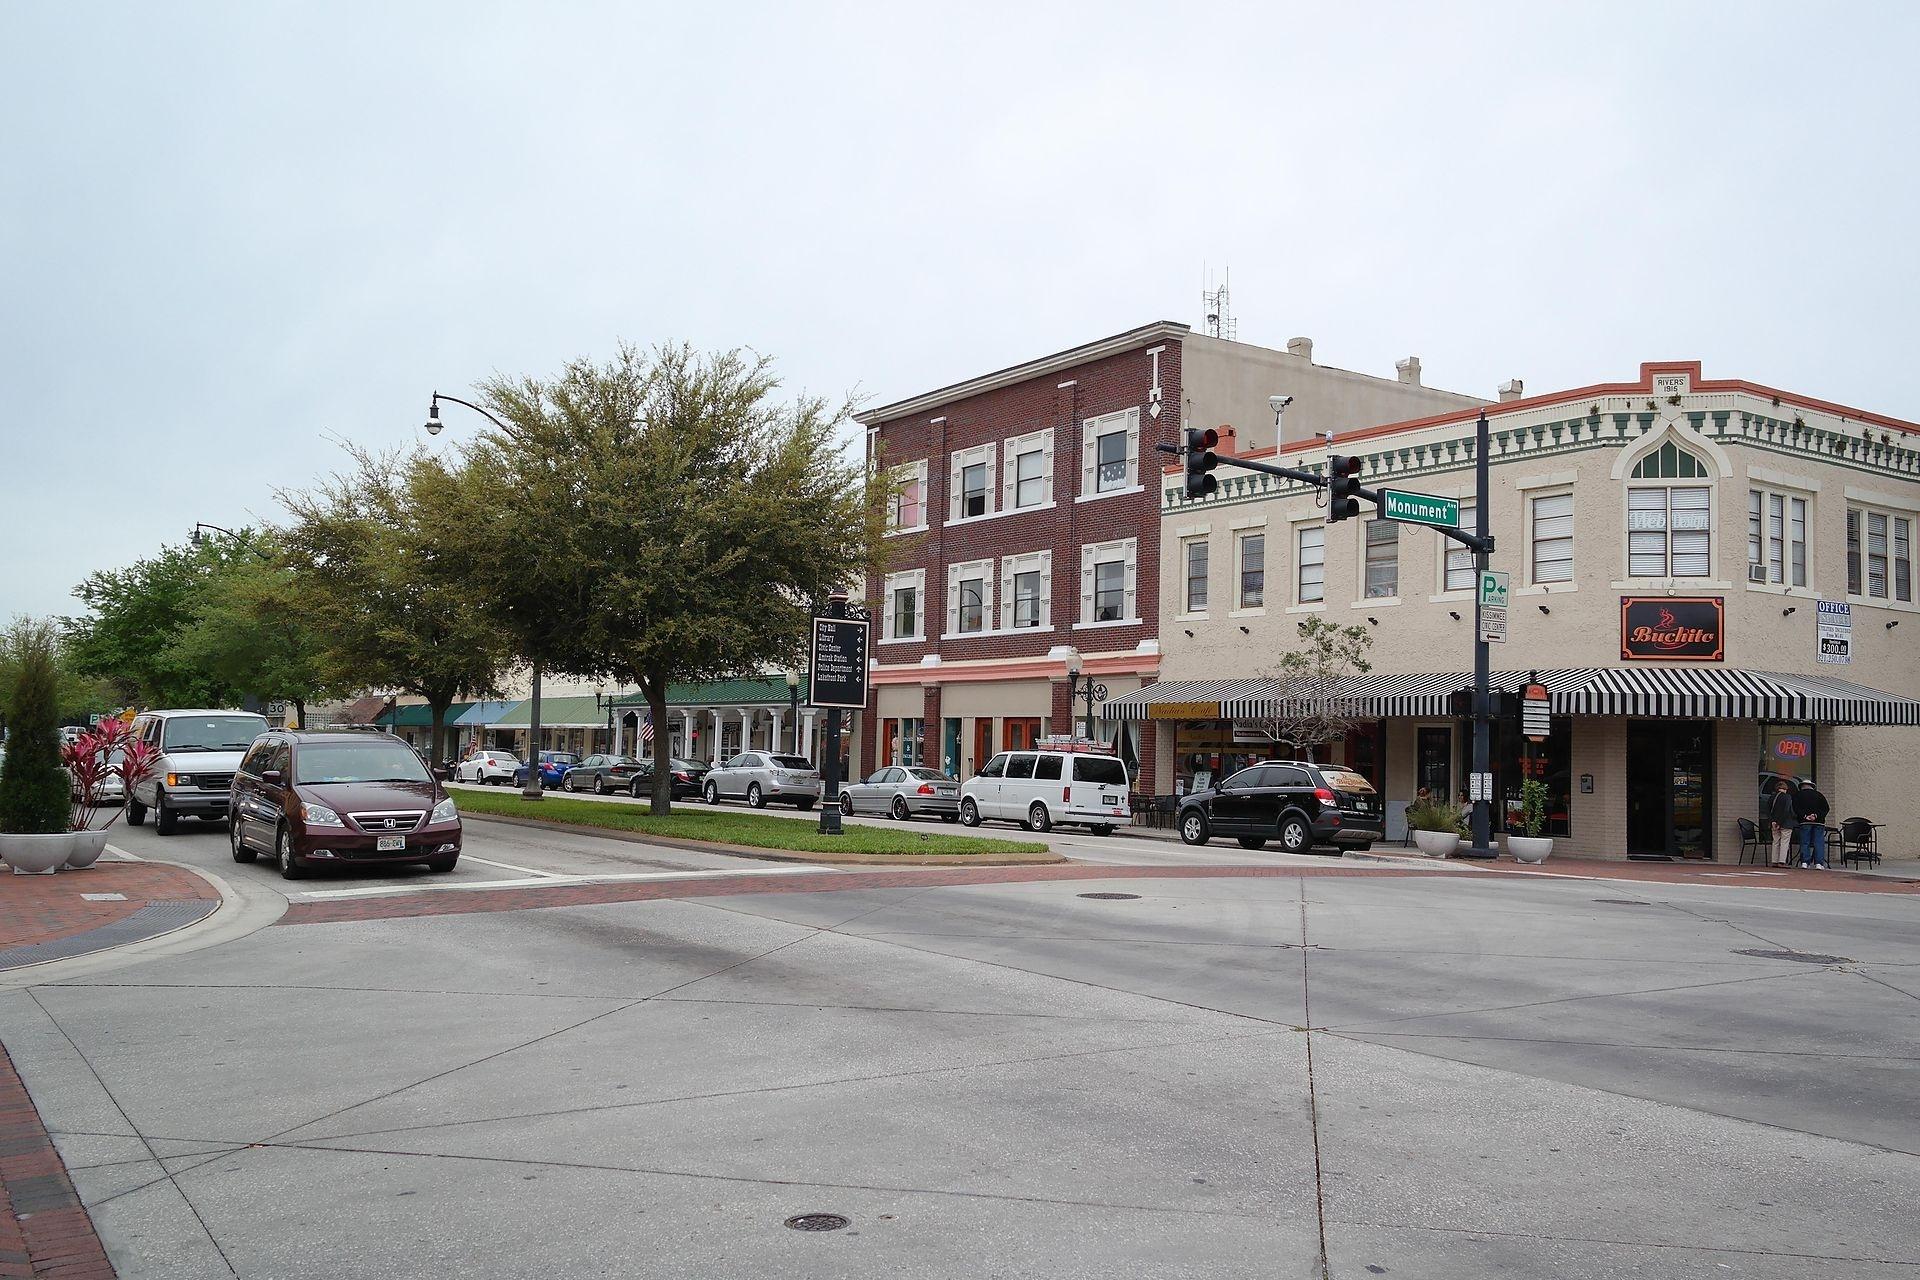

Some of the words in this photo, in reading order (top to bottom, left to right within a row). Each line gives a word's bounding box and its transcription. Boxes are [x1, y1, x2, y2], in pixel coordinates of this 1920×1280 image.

[1388, 496, 1447, 520] Monument
[1819, 602, 1849, 613] OFFICE
[1482, 610, 1505, 621] KISSIMMEE
[1482, 621, 1491, 630] CIVIC
[1492, 622, 1505, 632] CENTER
[819, 633, 834, 643] Library
[1630, 626, 1715, 643] Buchito
[829, 644, 841, 653] Center
[834, 654, 847, 663] Station
[817, 663, 830, 671] Police
[830, 664, 853, 673] Department
[817, 673, 836, 682] Lakefront
[837, 674, 847, 683] Park
[270, 704, 285, 713] 30
[1233, 719, 1259, 728] Nadia's
[1779, 740, 1806, 757] OPEN
